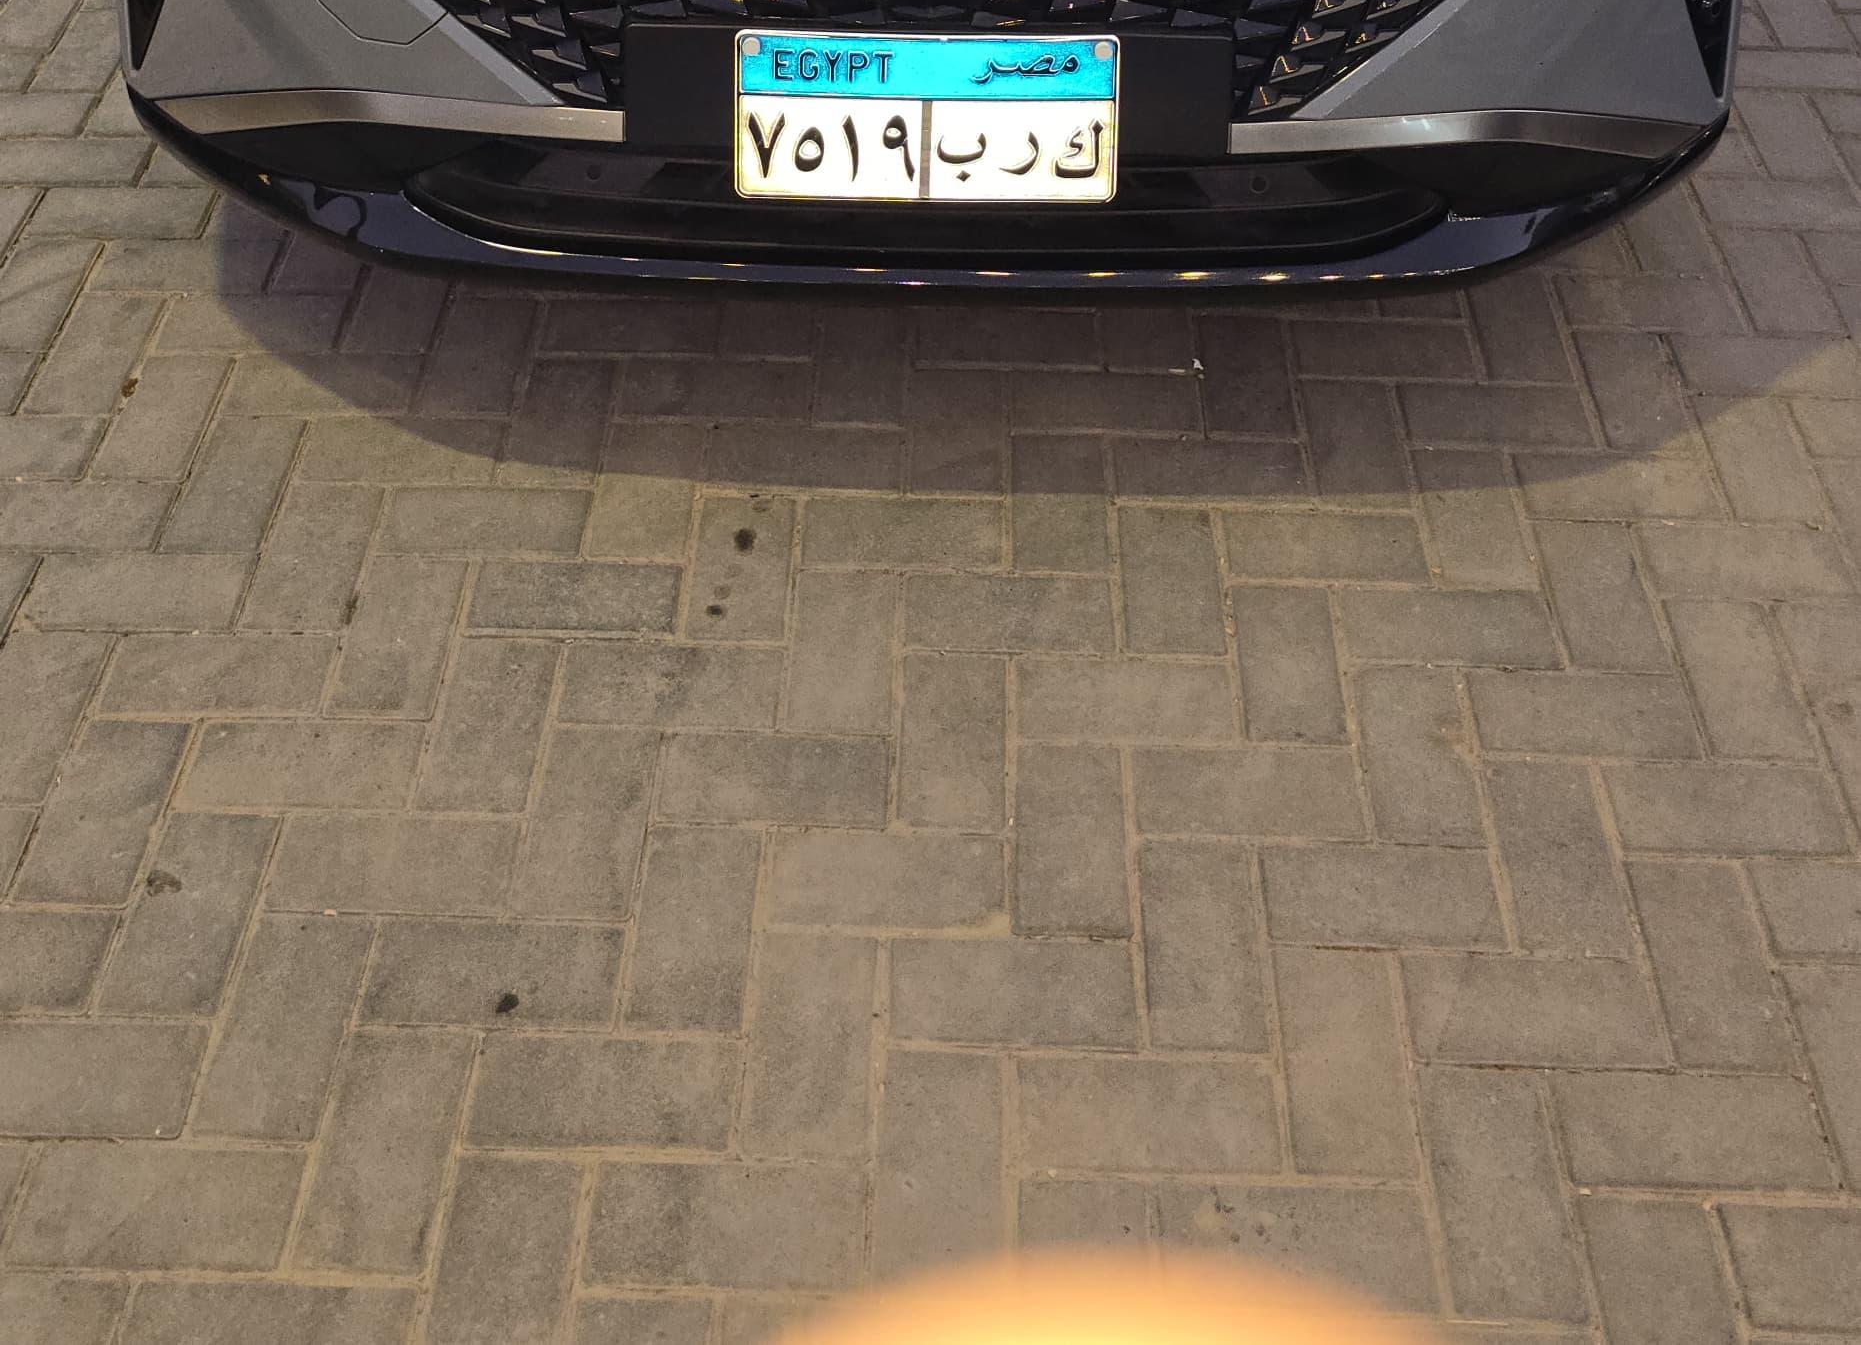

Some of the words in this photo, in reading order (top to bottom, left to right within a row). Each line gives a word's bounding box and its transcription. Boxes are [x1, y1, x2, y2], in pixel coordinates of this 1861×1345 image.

[772, 48, 896, 84] EGYPT
[970, 52, 1081, 85] مصر
[746, 111, 916, 183] ٧٥١٩
